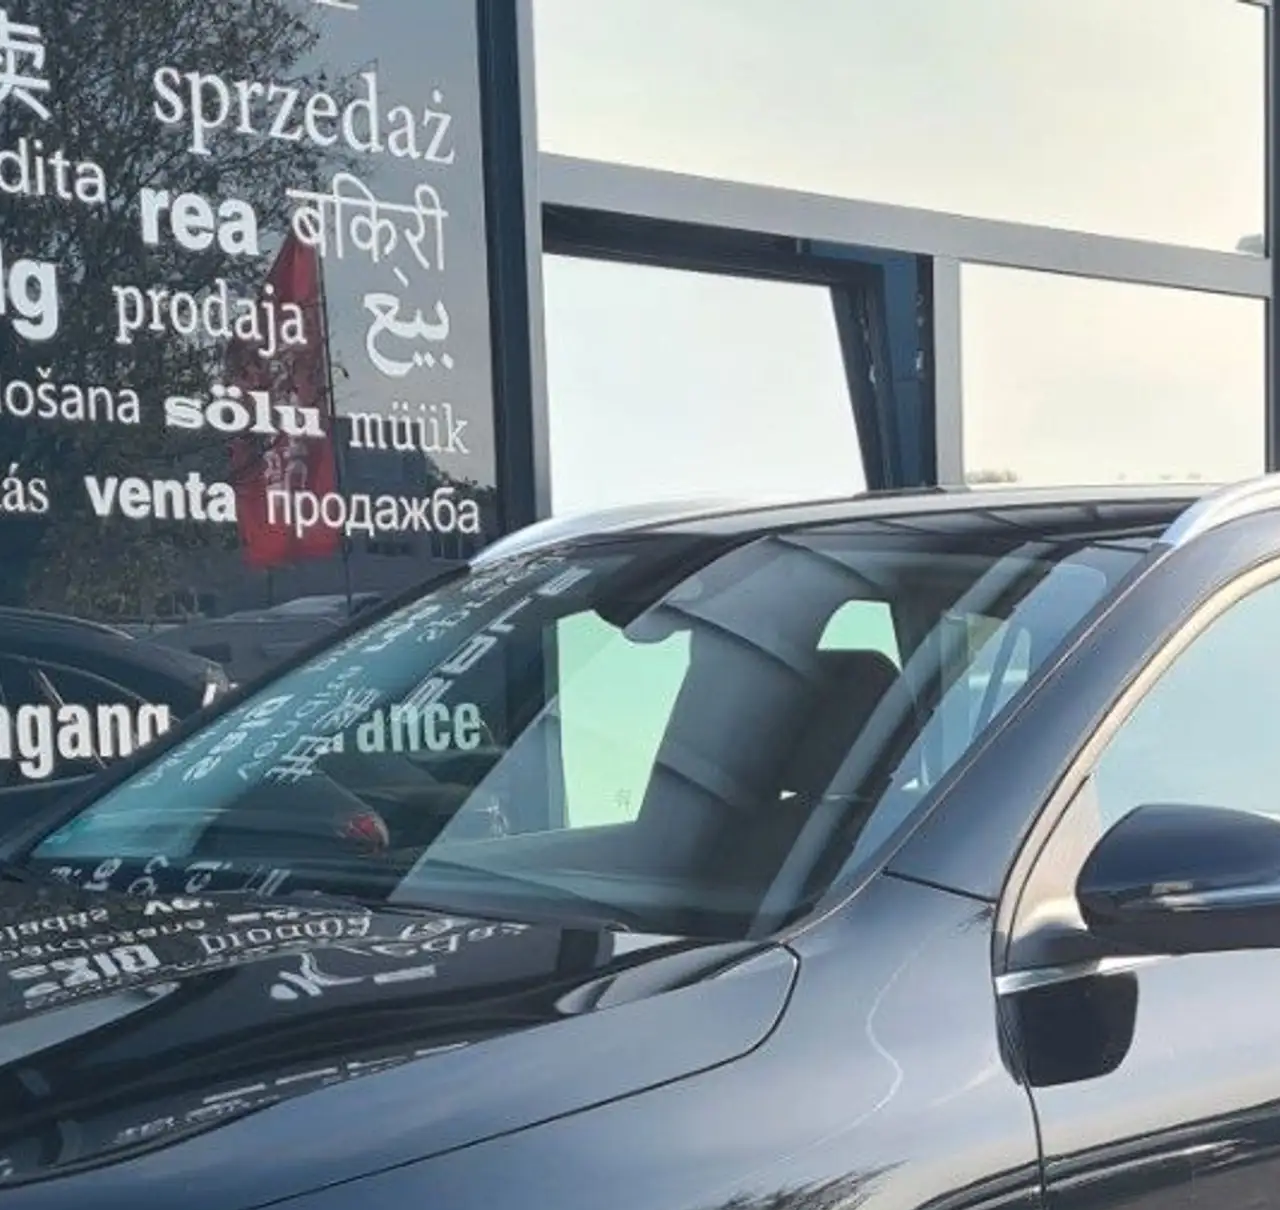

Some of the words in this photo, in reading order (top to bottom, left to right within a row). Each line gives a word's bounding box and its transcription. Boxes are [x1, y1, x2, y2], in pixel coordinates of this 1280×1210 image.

[152, 65, 455, 166] sprzedaż
[140, 187, 259, 257] rea
[112, 279, 308, 357] prodaja
[363, 292, 454, 377] بيع
[163, 383, 325, 437] sölu
[348, 402, 470, 456] müük
[84, 471, 238, 523] venta
[265, 484, 480, 538] продажба
